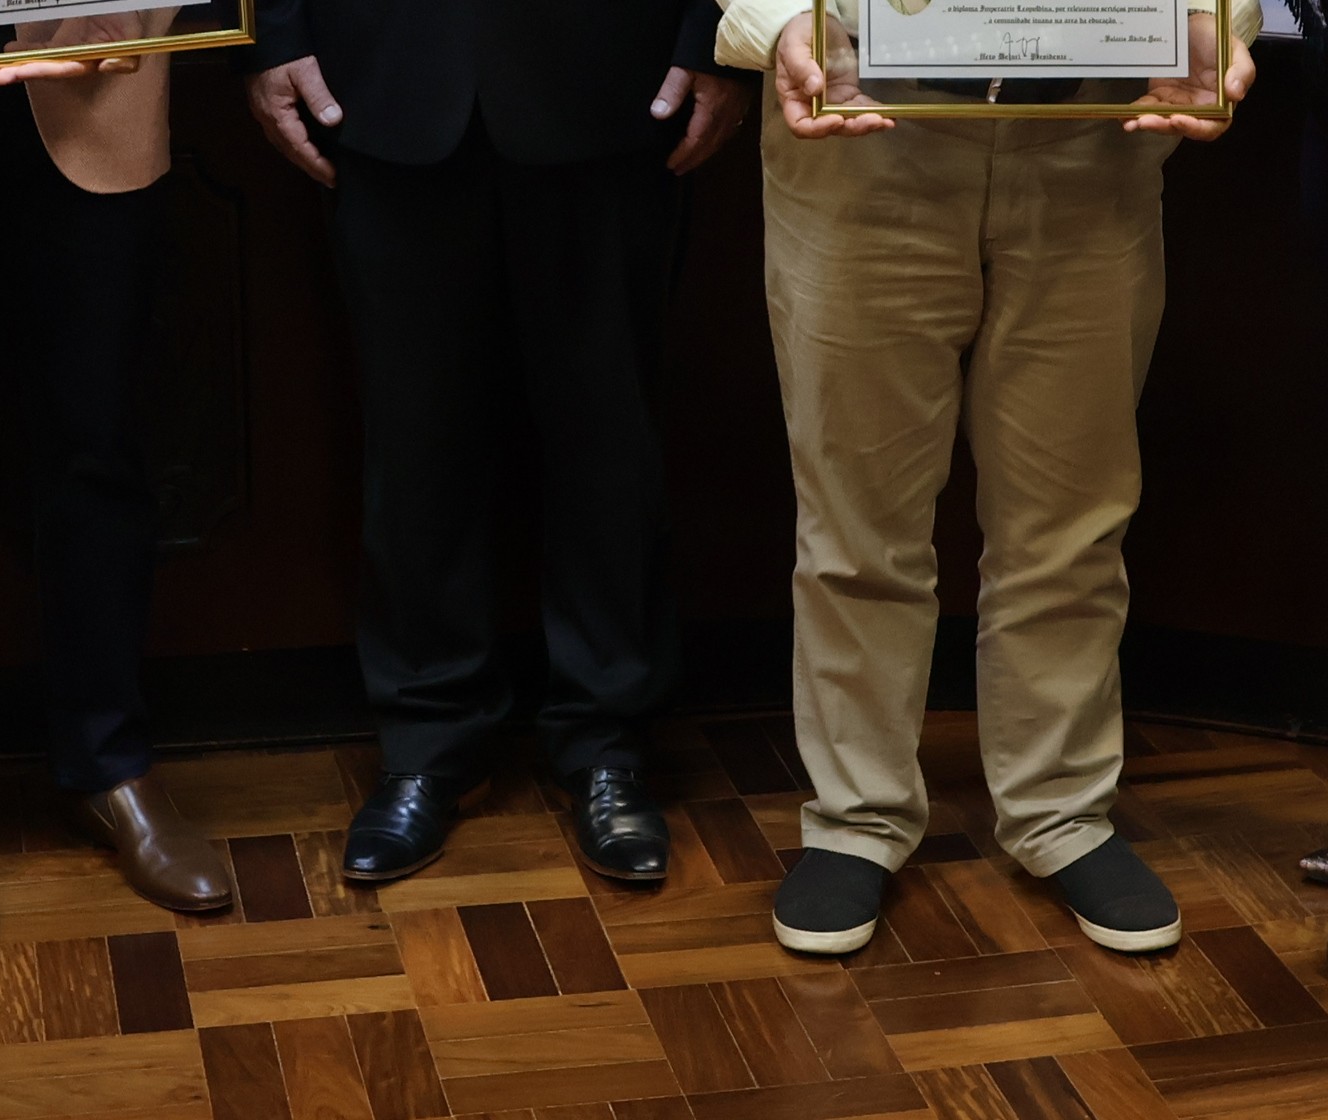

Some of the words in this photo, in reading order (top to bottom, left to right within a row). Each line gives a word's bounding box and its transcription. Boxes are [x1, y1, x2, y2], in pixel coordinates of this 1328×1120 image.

[952, 4, 978, 13] diploma
[980, 4, 1015, 13] Imperatriz
[1127, 5, 1158, 13] prestados
